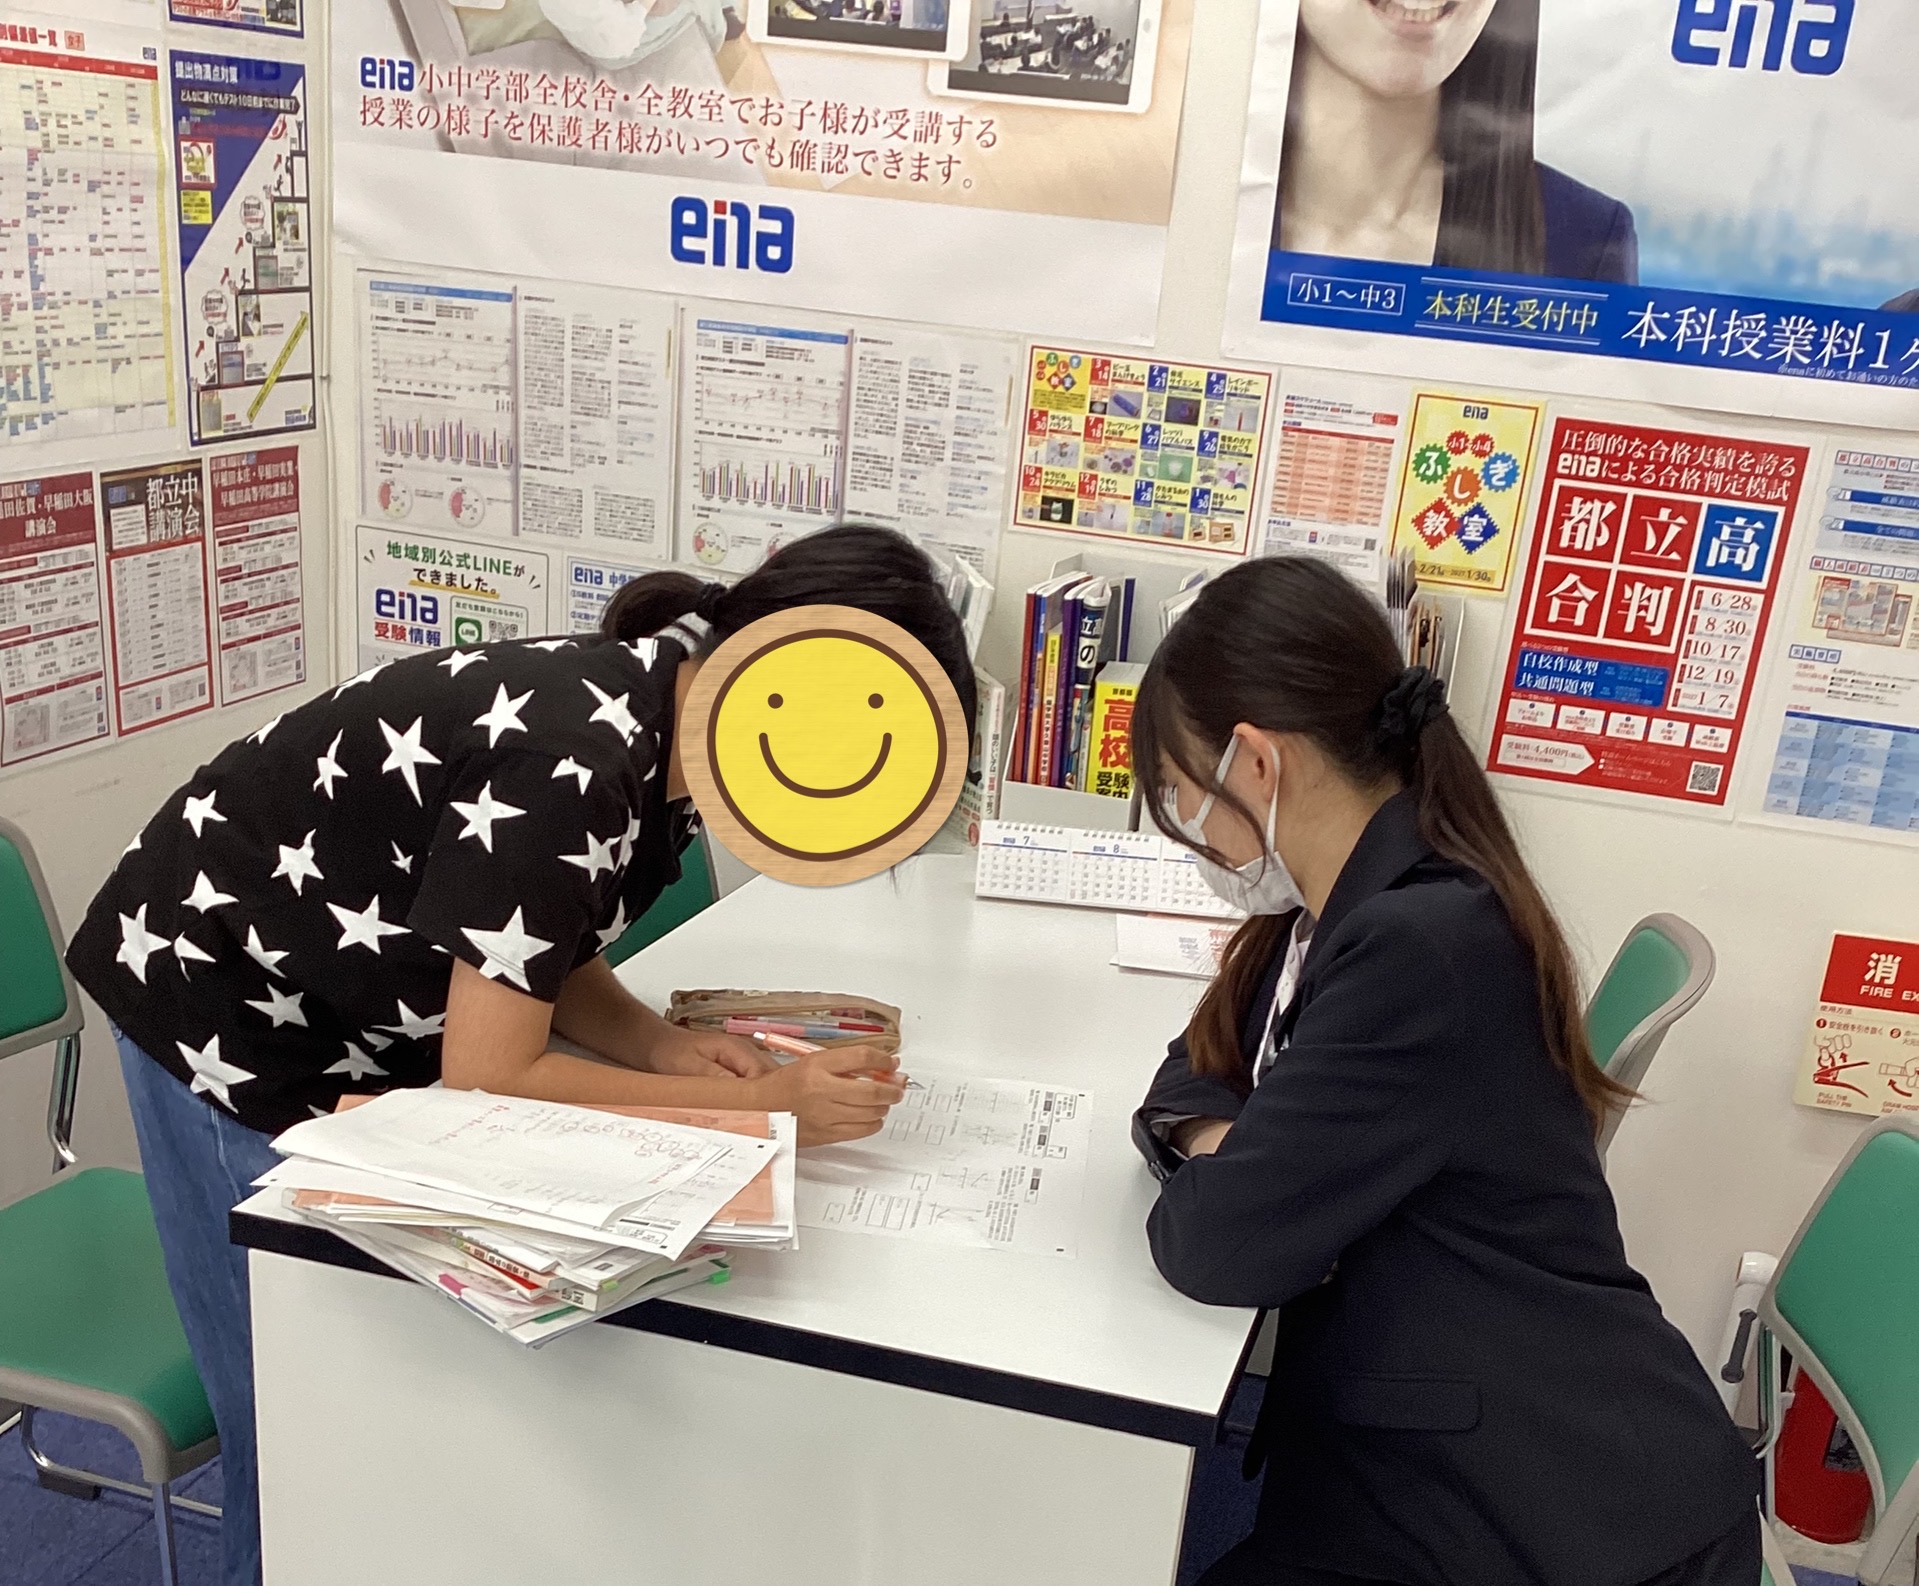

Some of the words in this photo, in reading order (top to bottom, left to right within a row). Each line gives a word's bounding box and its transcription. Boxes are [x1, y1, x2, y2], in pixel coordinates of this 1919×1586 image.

[1671, 0, 1858, 77] ena
[358, 93, 976, 190] 授業の様子を保護者様がいつでも確認できます。
[670, 195, 796, 274] ena
[1423, 289, 1599, 335] 本科生受付中
[1463, 404, 1489, 421] ena
[1561, 429, 1797, 477] 圧倒的な合格実績を誇る
[146, 472, 199, 511] 都立中
[1557, 453, 1791, 502] enaによる合格判定模試
[147, 503, 200, 542] 講演会
[1422, 508, 1488, 542] 教室
[386, 540, 526, 578] 地域別公式LINEが
[413, 567, 498, 595] できました。
[574, 566, 603, 586] ena
[375, 587, 439, 625] ena
[374, 621, 442, 648] 受験情報
[1692, 640, 1741, 660] 10/17
[1523, 651, 1600, 677] 自校作成型
[1686, 664, 1735, 684] 12/19
[1518, 672, 1595, 697] 共通問題型
[1096, 770, 1130, 790] 受験
[1864, 952, 1902, 985] 消
[1860, 985, 1894, 999] FIRE
